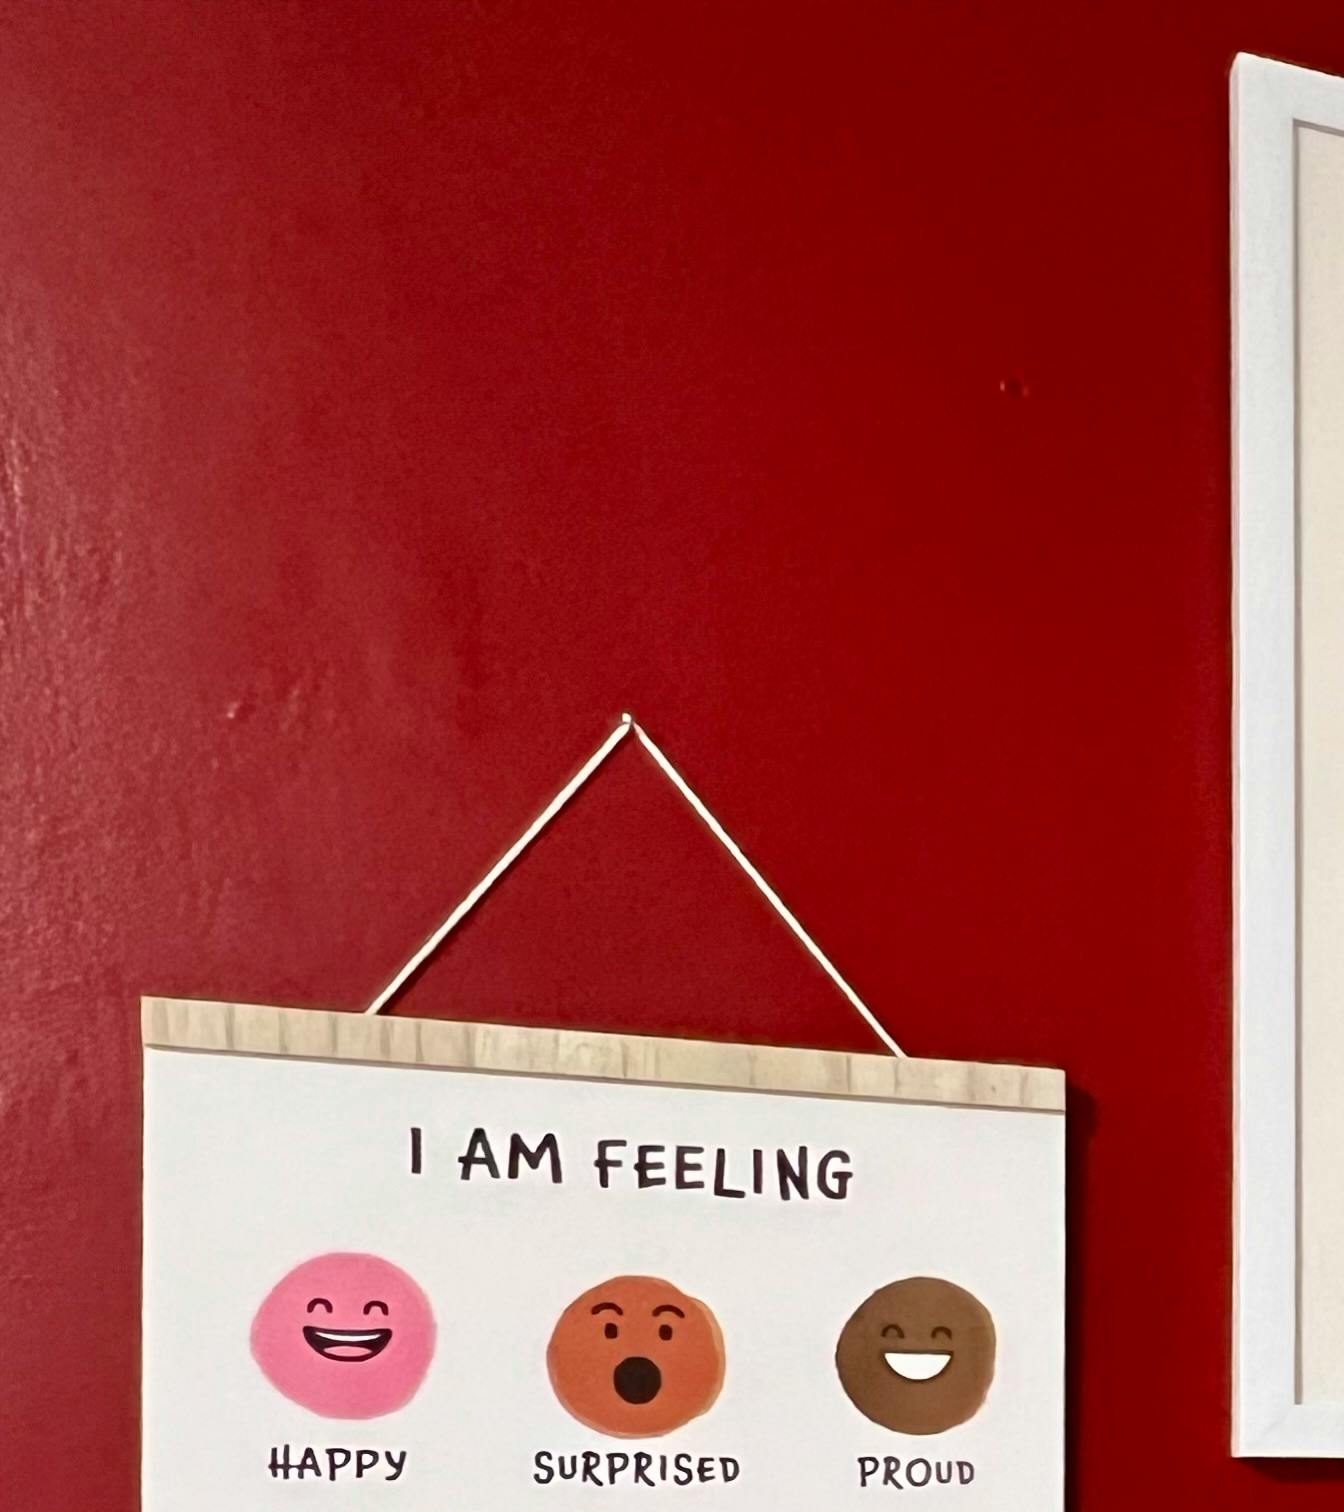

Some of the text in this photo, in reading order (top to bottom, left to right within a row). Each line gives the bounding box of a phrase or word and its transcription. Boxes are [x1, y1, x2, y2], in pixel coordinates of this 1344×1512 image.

[409, 1126, 854, 1202] I AM FEELING
[268, 1443, 408, 1483] HAPPY
[532, 1449, 741, 1488] SURPRISED
[857, 1455, 975, 1491] PROUD
